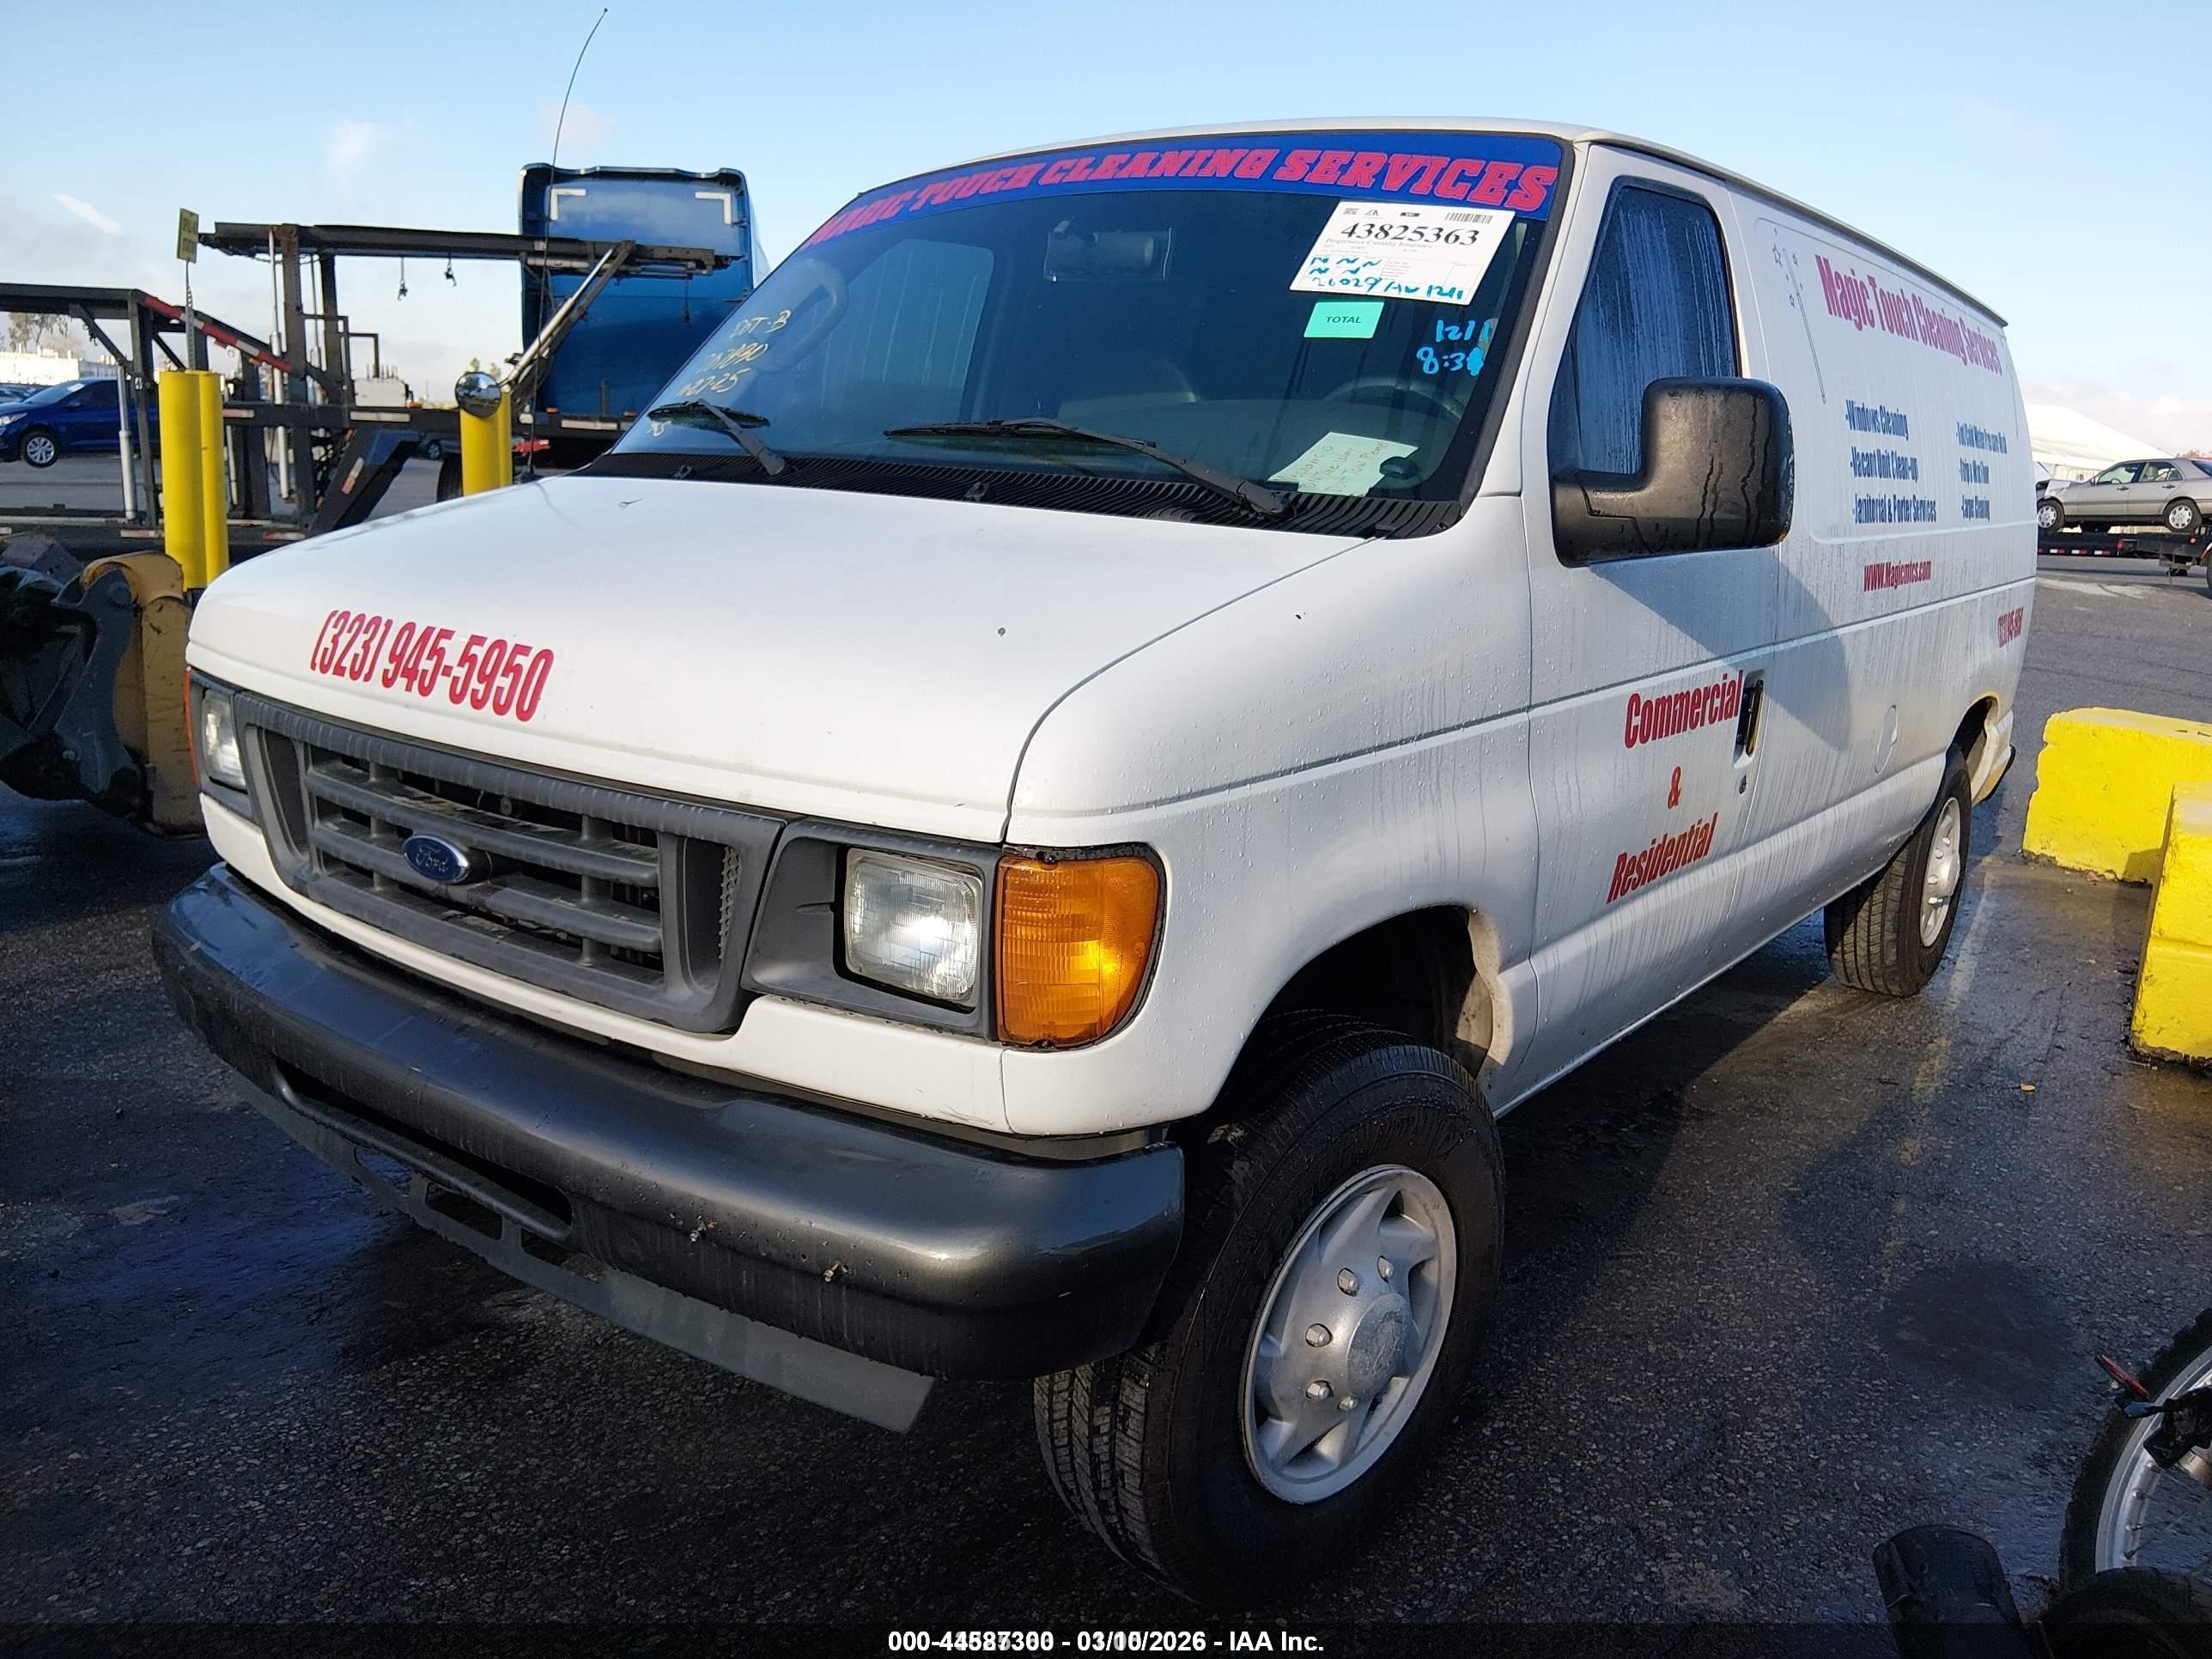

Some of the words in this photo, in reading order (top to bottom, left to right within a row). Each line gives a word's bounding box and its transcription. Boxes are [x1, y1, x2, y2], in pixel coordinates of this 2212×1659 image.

[803, 190, 917, 250] MAGIC
[909, 162, 1047, 212] TOUCH
[1038, 149, 1279, 185] CLEANING
[1273, 149, 1559, 212] SERVICES
[1341, 222, 1480, 246] 43825363
[1814, 254, 1875, 331] Magic
[1867, 275, 1918, 341] Touch
[1911, 293, 1967, 366] Cleaning
[1960, 317, 2002, 376] Services
[1880, 404, 1909, 441] Cleaning
[1876, 448, 1891, 479] Unit
[1887, 498, 1893, 523] &
[1893, 494, 1911, 523] Porter
[1912, 494, 1936, 523] Services
[311, 611, 393, 682] (323)
[381, 622, 554, 721] 945-5950
[1625, 670, 1743, 749] Commercial
[1668, 766, 1681, 809] &
[1606, 812, 1718, 904] Residential
